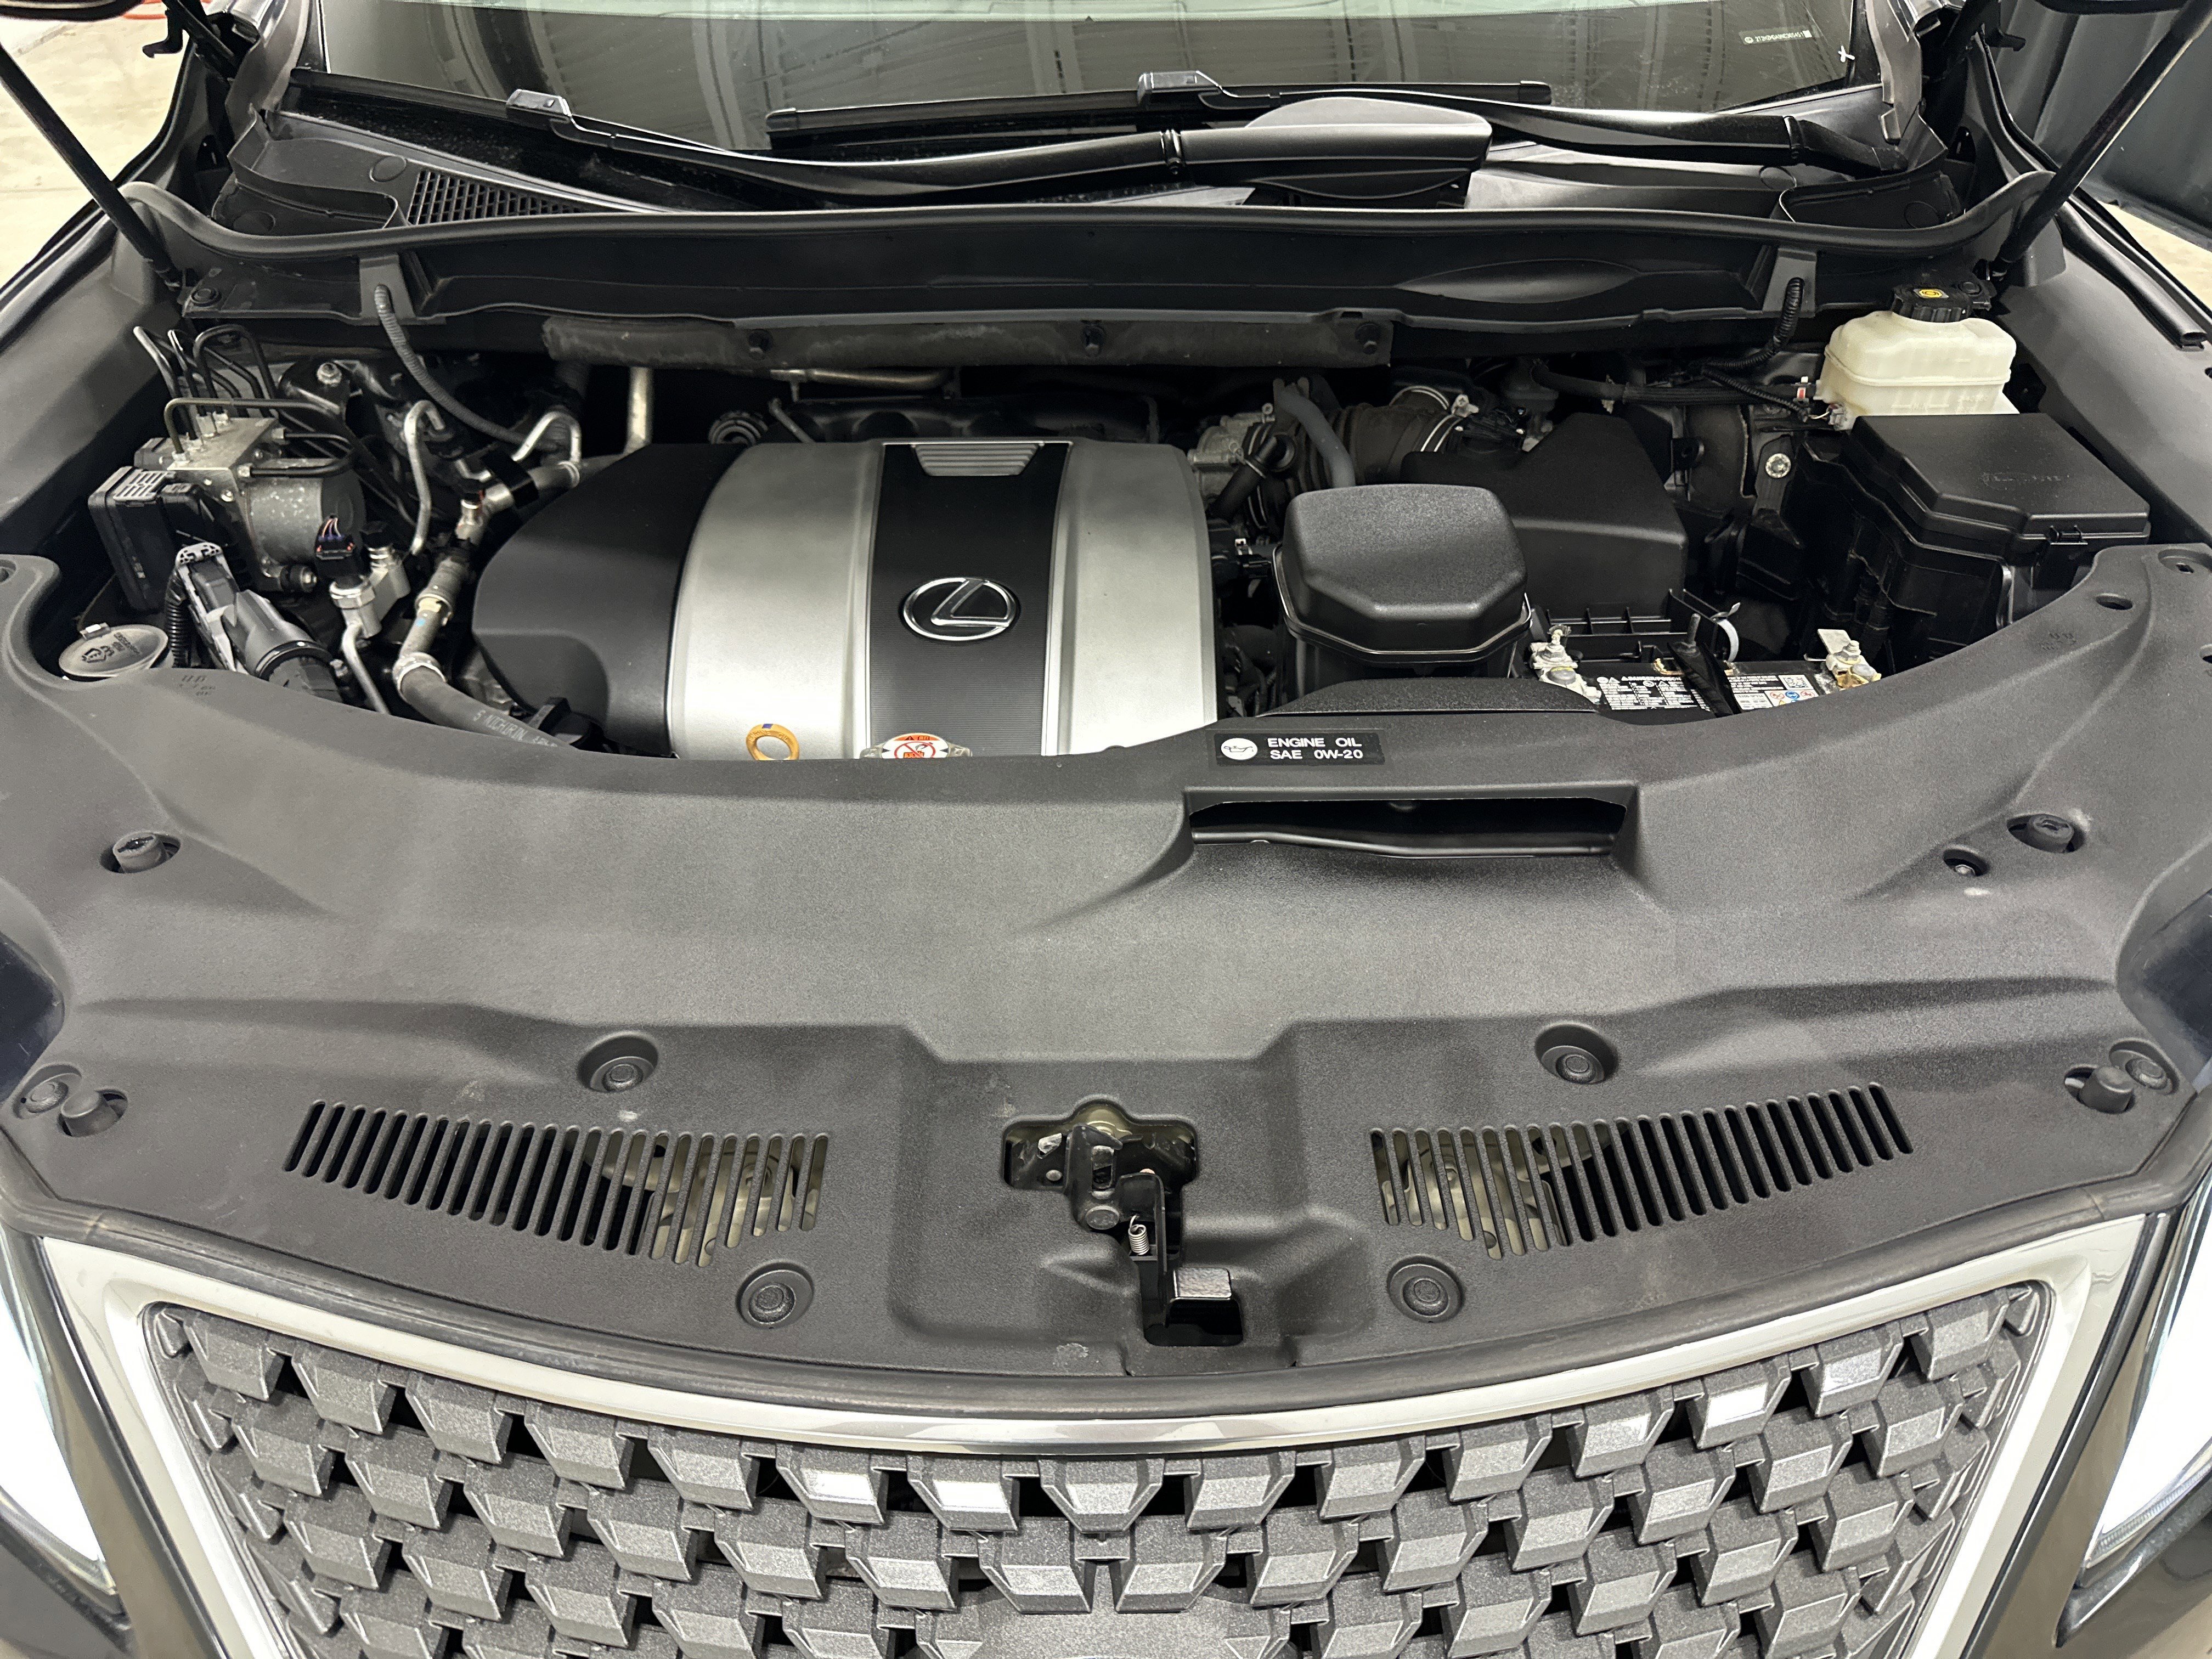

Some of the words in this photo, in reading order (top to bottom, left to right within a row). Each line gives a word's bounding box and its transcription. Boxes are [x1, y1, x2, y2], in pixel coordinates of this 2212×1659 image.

[1267, 737, 1325, 747] ENGINE
[1335, 737, 1362, 747] OIL
[1270, 749, 1303, 759] SAE
[1313, 749, 1363, 759] 0W-20
